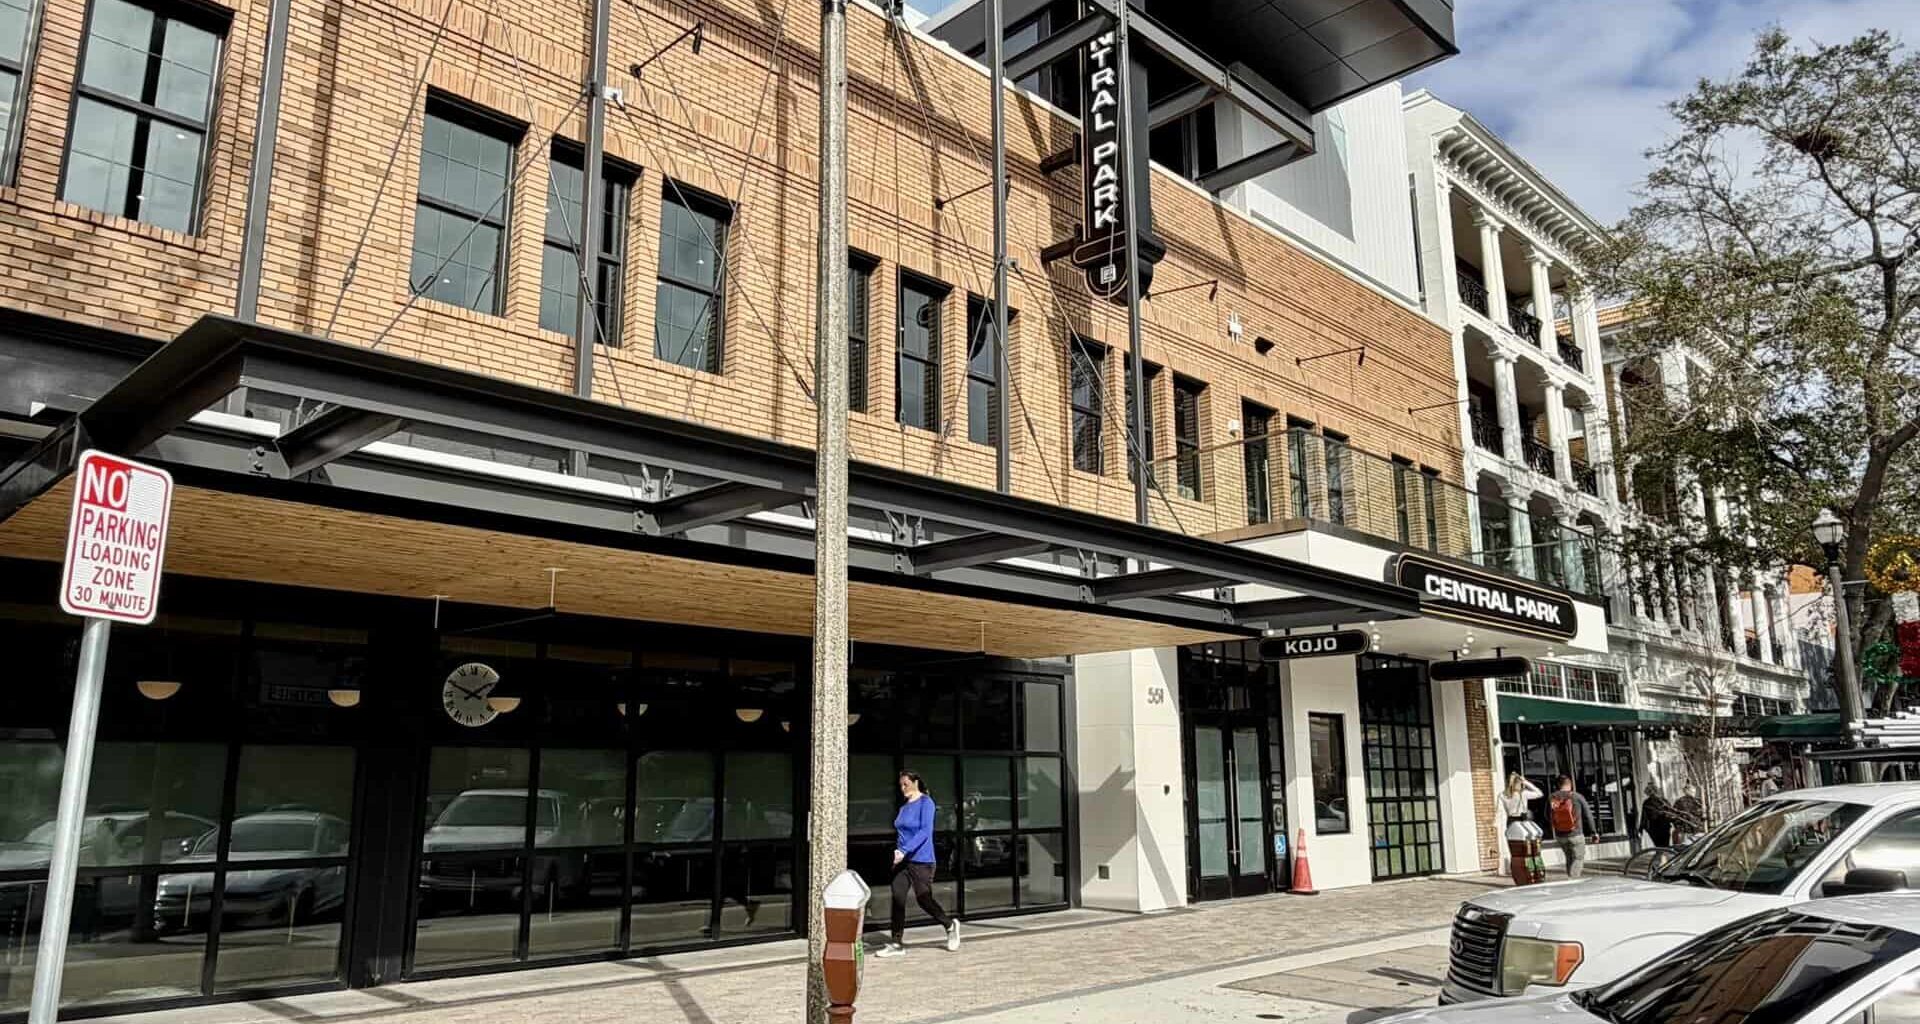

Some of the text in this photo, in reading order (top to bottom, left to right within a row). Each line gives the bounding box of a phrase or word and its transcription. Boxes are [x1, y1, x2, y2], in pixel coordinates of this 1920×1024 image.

[1090, 31, 1118, 229] NTRAL PARK
[83, 463, 129, 509] NO
[81, 507, 158, 551] PARKING
[81, 540, 152, 571] LOADING
[92, 566, 136, 591] ZONE
[74, 585, 146, 611] 30 MINUTE
[1425, 574, 1561, 625] CENTRAL PARK
[1285, 637, 1337, 654] KOJO
[1147, 687, 1164, 704] 551
